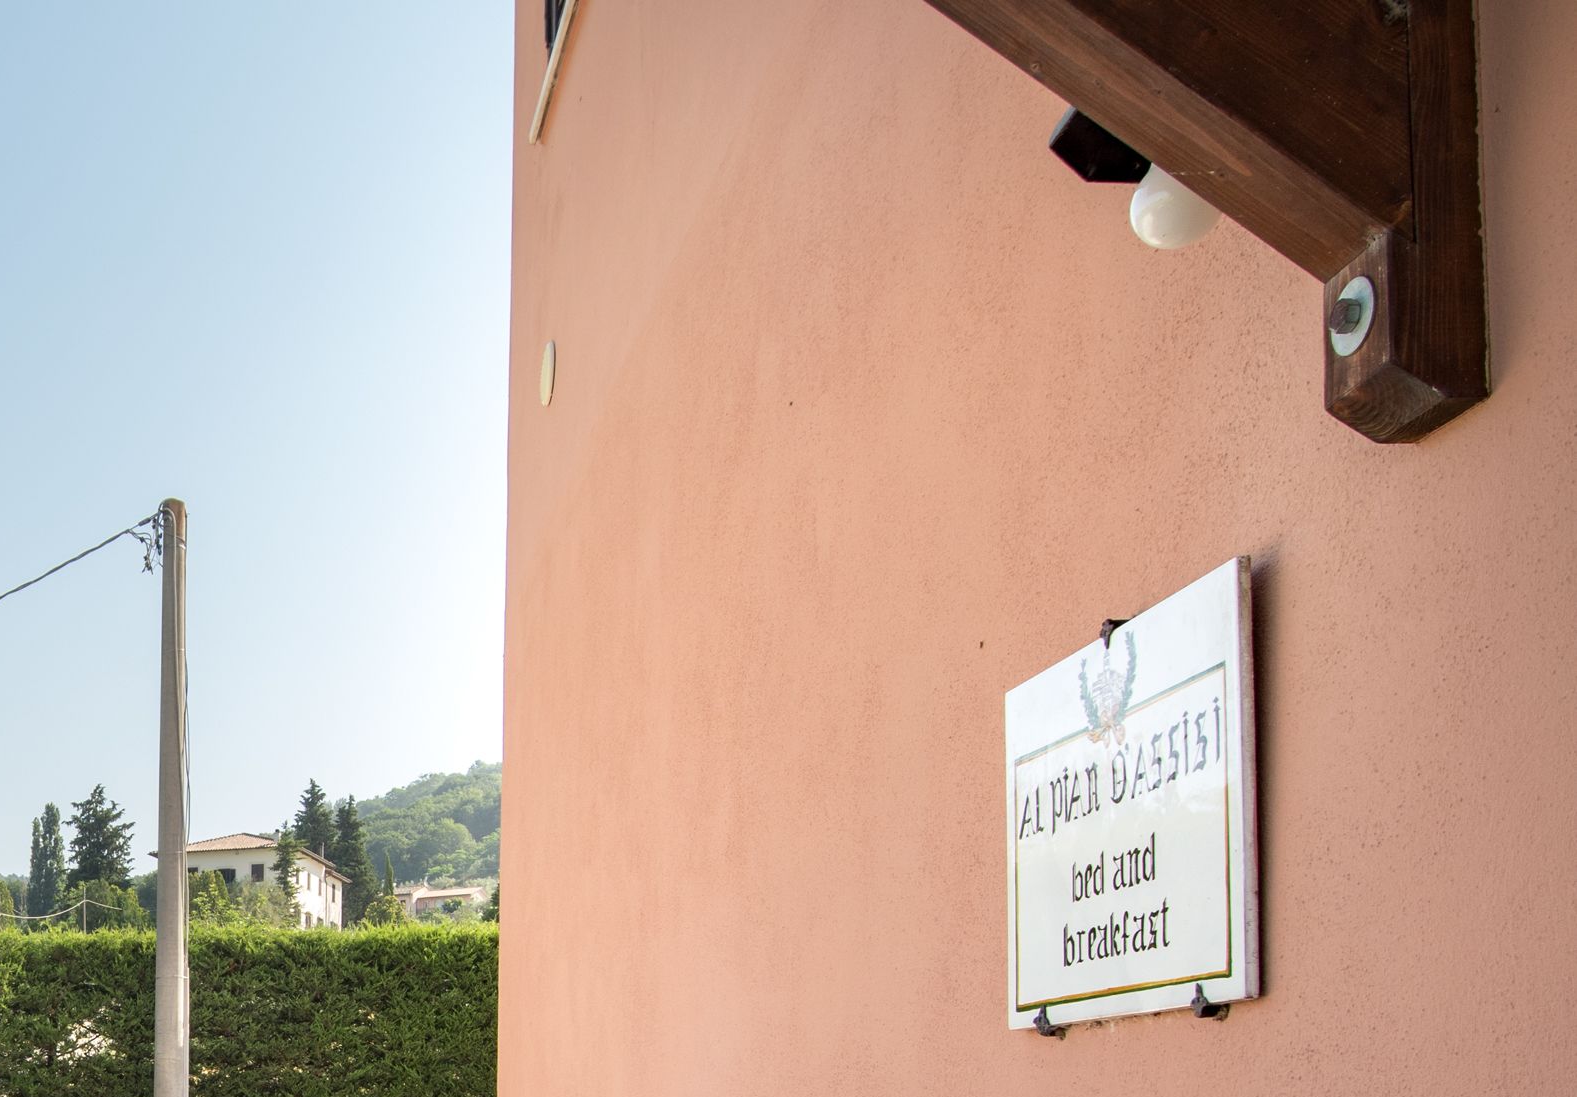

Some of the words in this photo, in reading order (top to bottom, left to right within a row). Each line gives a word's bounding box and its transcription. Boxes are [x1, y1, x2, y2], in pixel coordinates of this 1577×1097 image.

[1072, 850, 1105, 903] bed
[1113, 831, 1156, 891] and
[1063, 897, 1171, 968] breakfast
